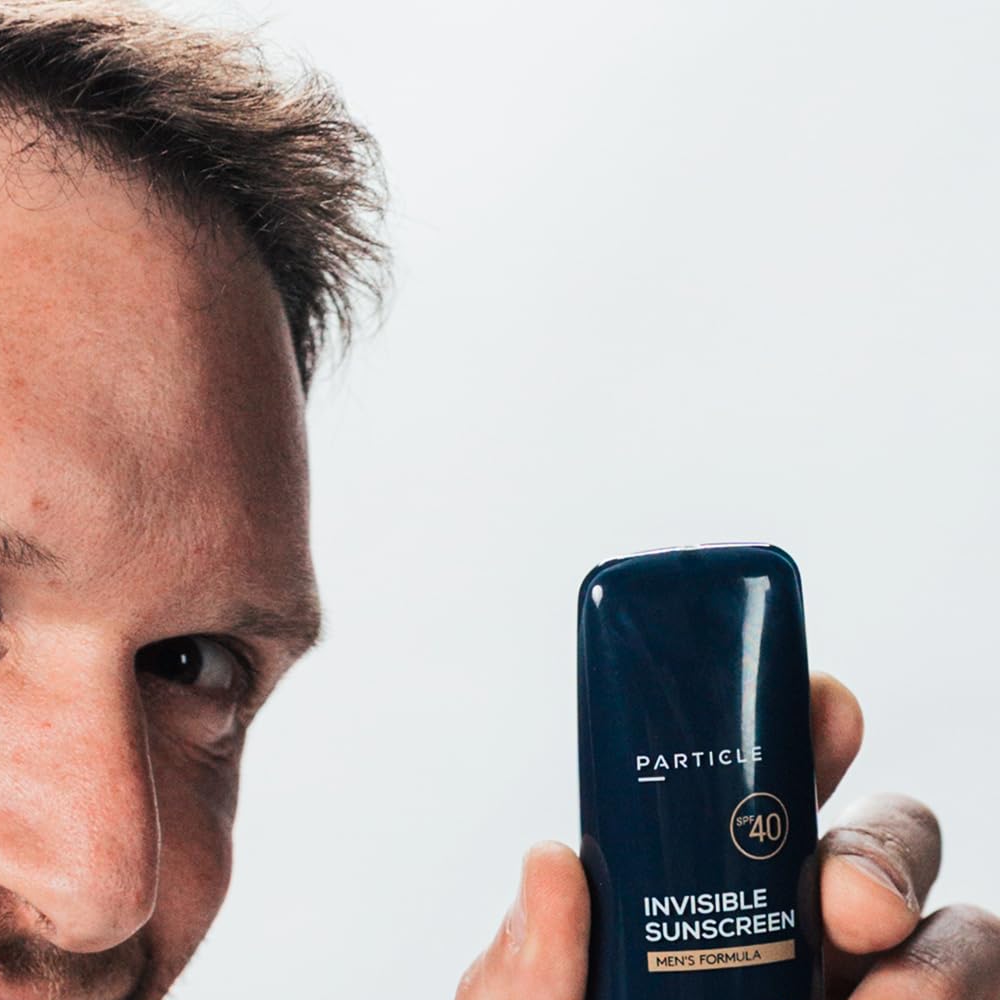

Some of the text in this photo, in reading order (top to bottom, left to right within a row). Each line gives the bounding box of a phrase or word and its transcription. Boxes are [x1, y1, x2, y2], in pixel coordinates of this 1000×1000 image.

[636, 746, 762, 771] PARTICLE
[736, 813, 781, 842] SPF 40
[644, 888, 767, 916] INVISIBLE
[645, 909, 795, 942] SUNSCREEN
[656, 950, 762, 967] MEN'S FORMULA
